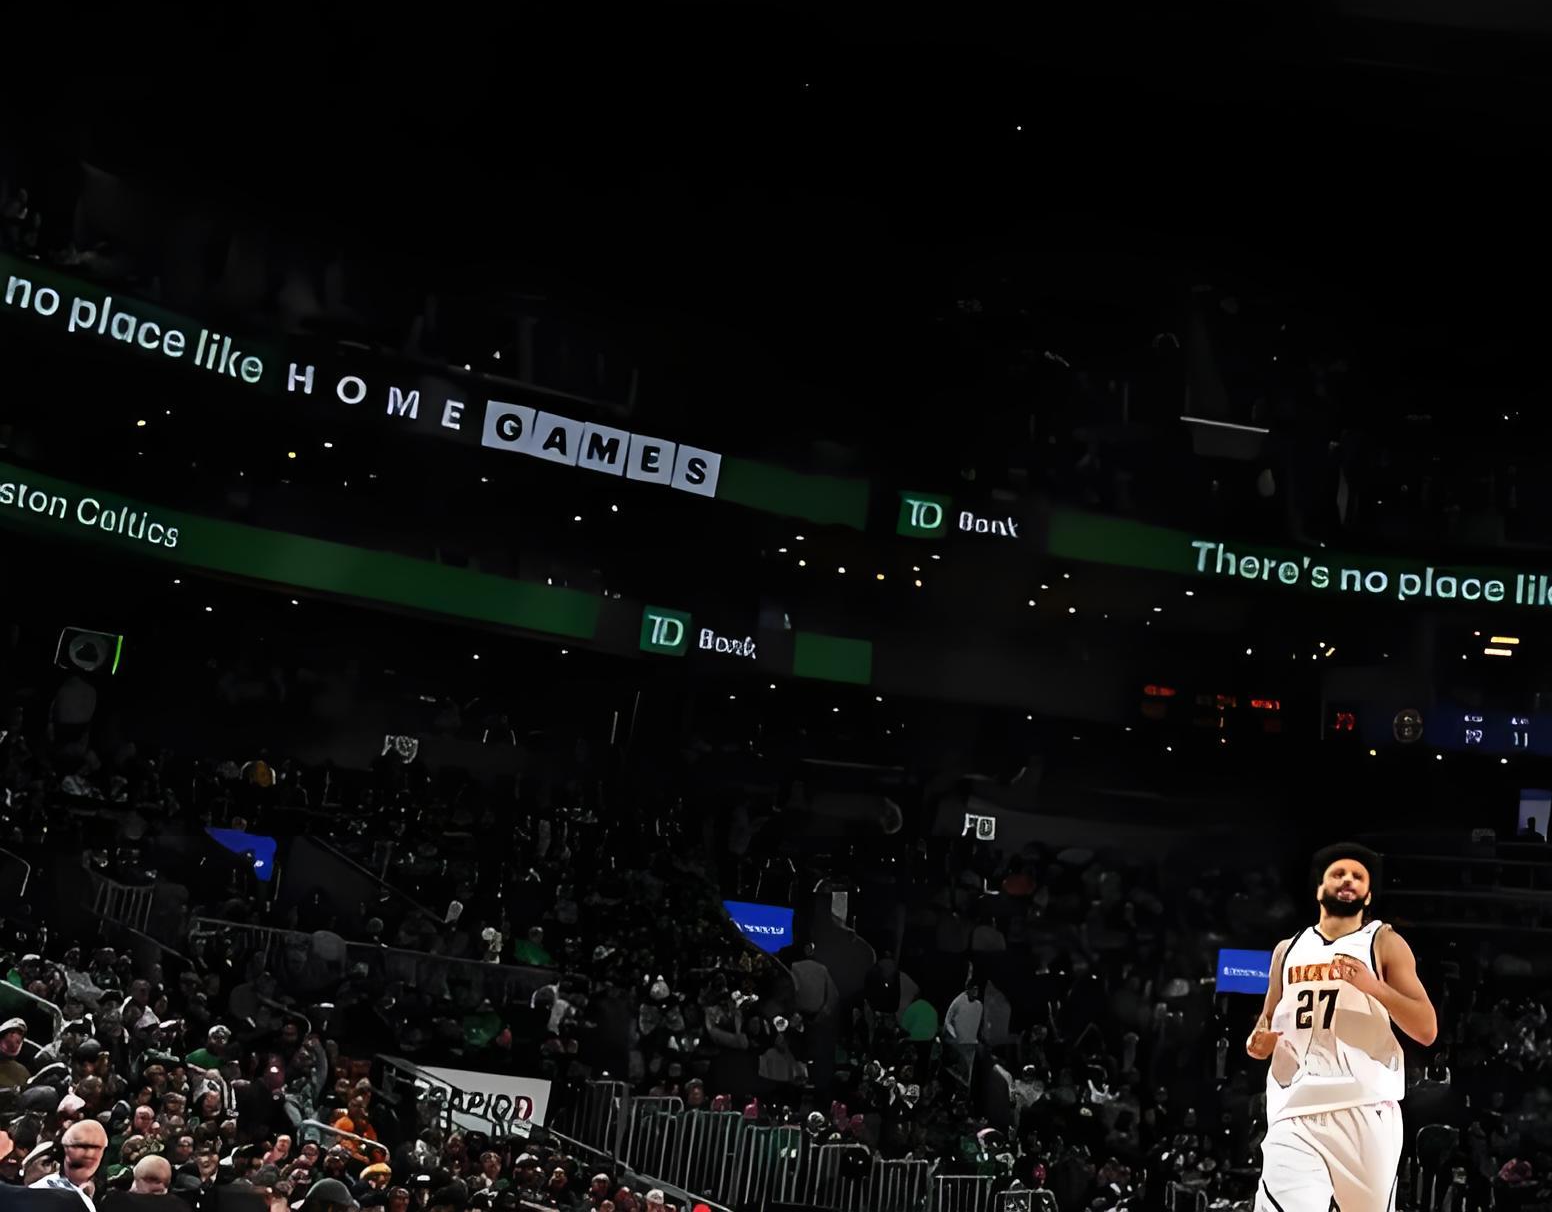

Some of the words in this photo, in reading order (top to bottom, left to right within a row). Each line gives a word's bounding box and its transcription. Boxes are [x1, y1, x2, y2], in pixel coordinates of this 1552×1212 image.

[5, 275, 60, 317] no
[67, 296, 187, 358] place
[194, 328, 263, 384] like
[287, 362, 465, 431] HOME
[495, 413, 708, 486] GAMES
[906, 499, 943, 529] TD
[1191, 540, 1331, 590] There's
[1340, 569, 1388, 593] no
[1398, 567, 1505, 601] place
[649, 614, 684, 647] TD
[1296, 989, 1340, 1029] 27
